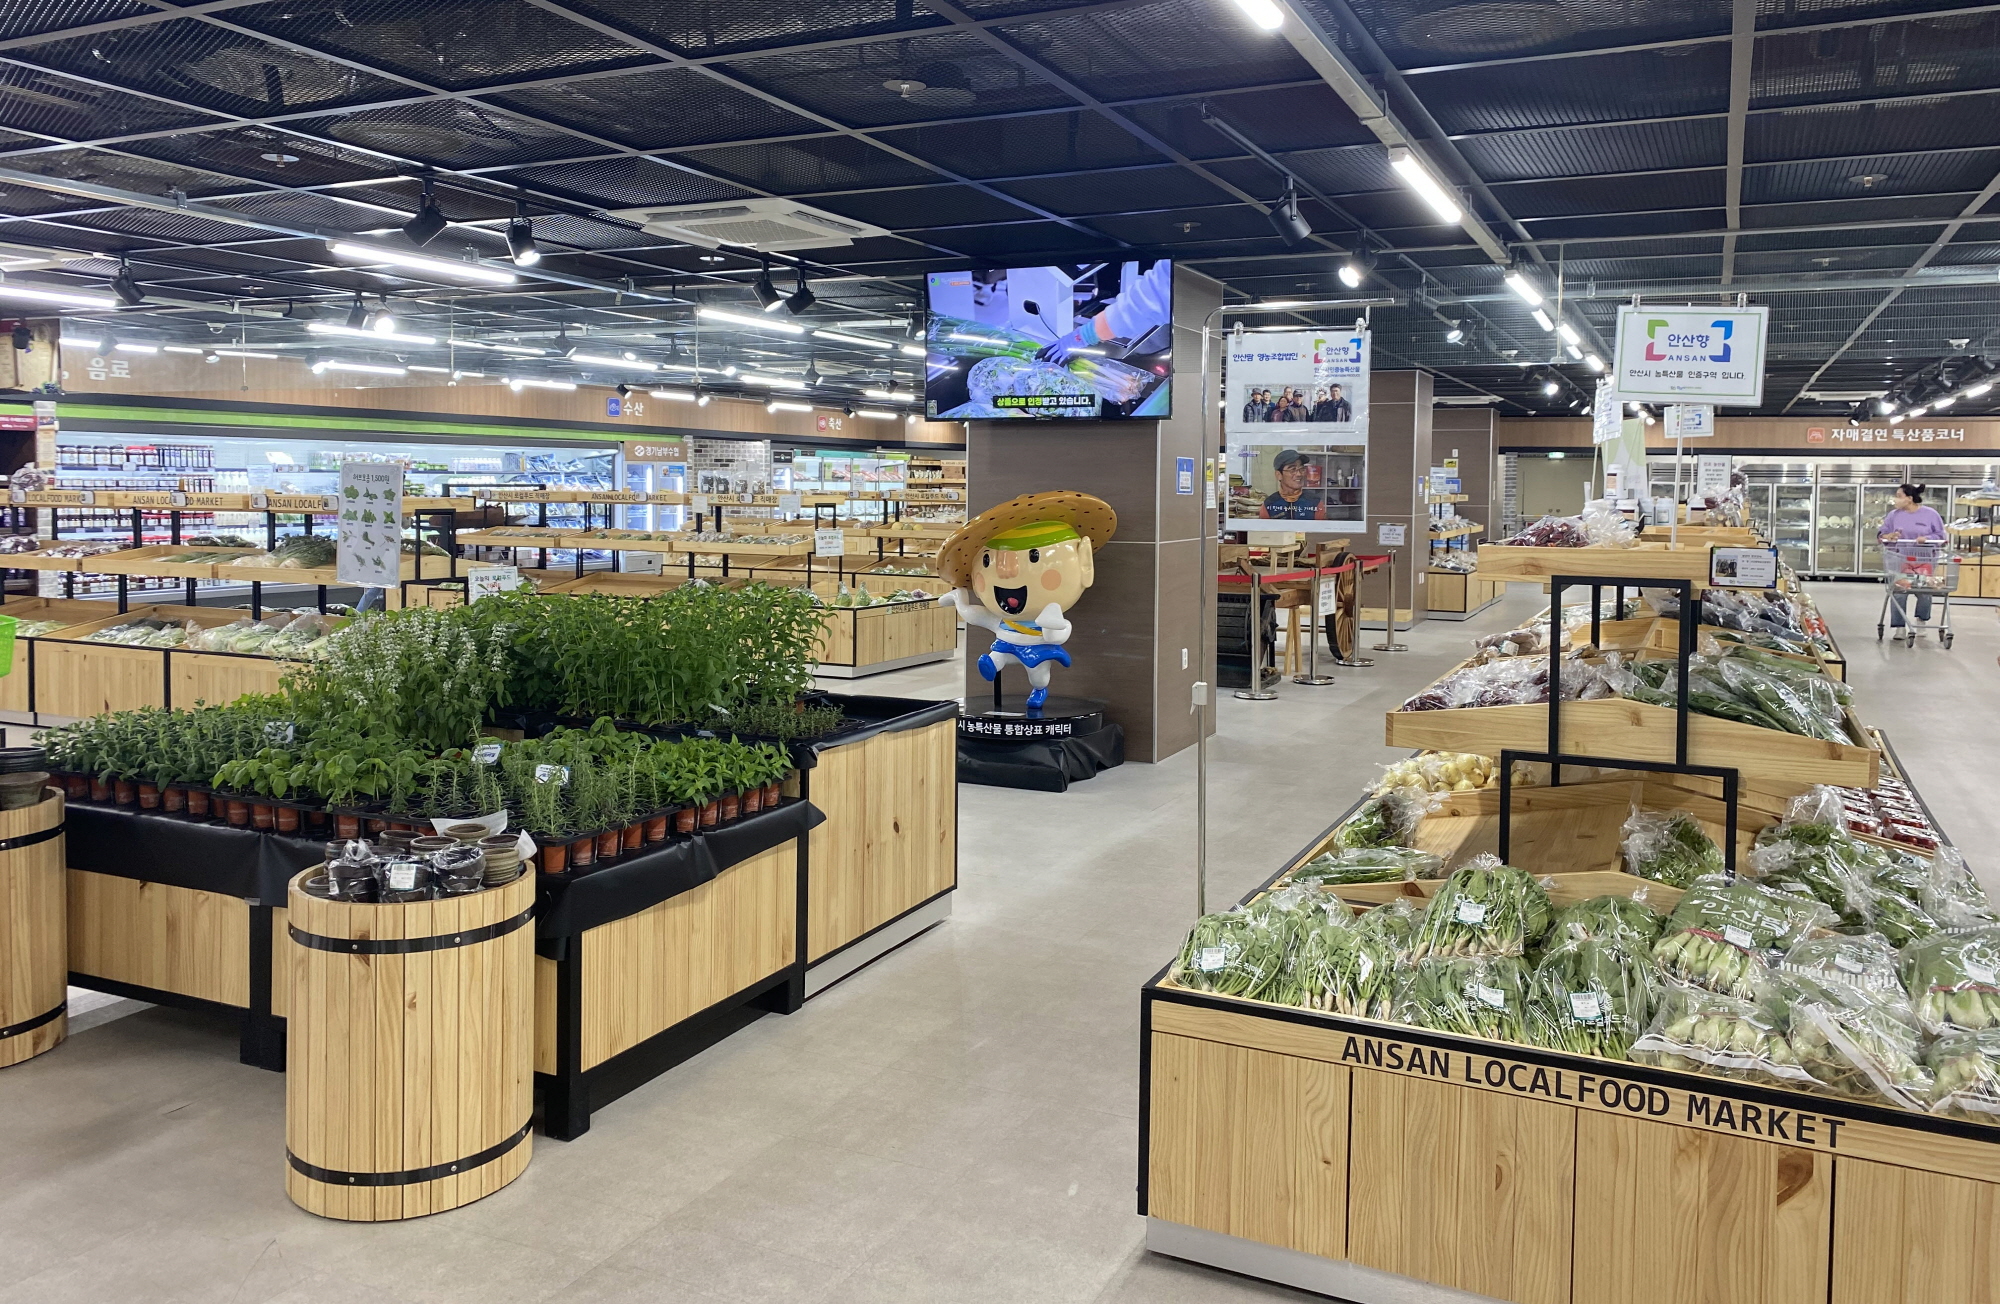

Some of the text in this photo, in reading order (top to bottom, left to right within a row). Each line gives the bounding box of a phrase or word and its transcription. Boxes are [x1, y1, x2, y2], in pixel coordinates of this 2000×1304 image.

[1667, 334, 1710, 348] 안산향
[1325, 346, 1350, 356] 안산향
[1668, 354, 1706, 362] ANSAN
[86, 357, 131, 381] 음료
[1629, 369, 1651, 378] 안산시
[1654, 370, 1684, 379] 농특산물
[1687, 371, 1718, 380] 인증구역
[1058, 396, 1092, 406] 있습니다.
[622, 401, 645, 417] 수산
[828, 417, 843, 431] 축산
[1831, 428, 1965, 442] 자매결연 특산품코너
[64, 494, 81, 503] MARK
[133, 495, 154, 504] ANSAN
[196, 497, 224, 506] MARKET
[268, 499, 292, 508] ANSAN
[717, 494, 735, 503] 안산시
[967, 722, 1003, 735] 농특산물
[1004, 723, 1043, 736] 통합상표
[1045, 723, 1072, 735] 캐릭터
[1341, 1036, 1451, 1079] ANSAN
[1686, 1096, 1847, 1150] MARKET
